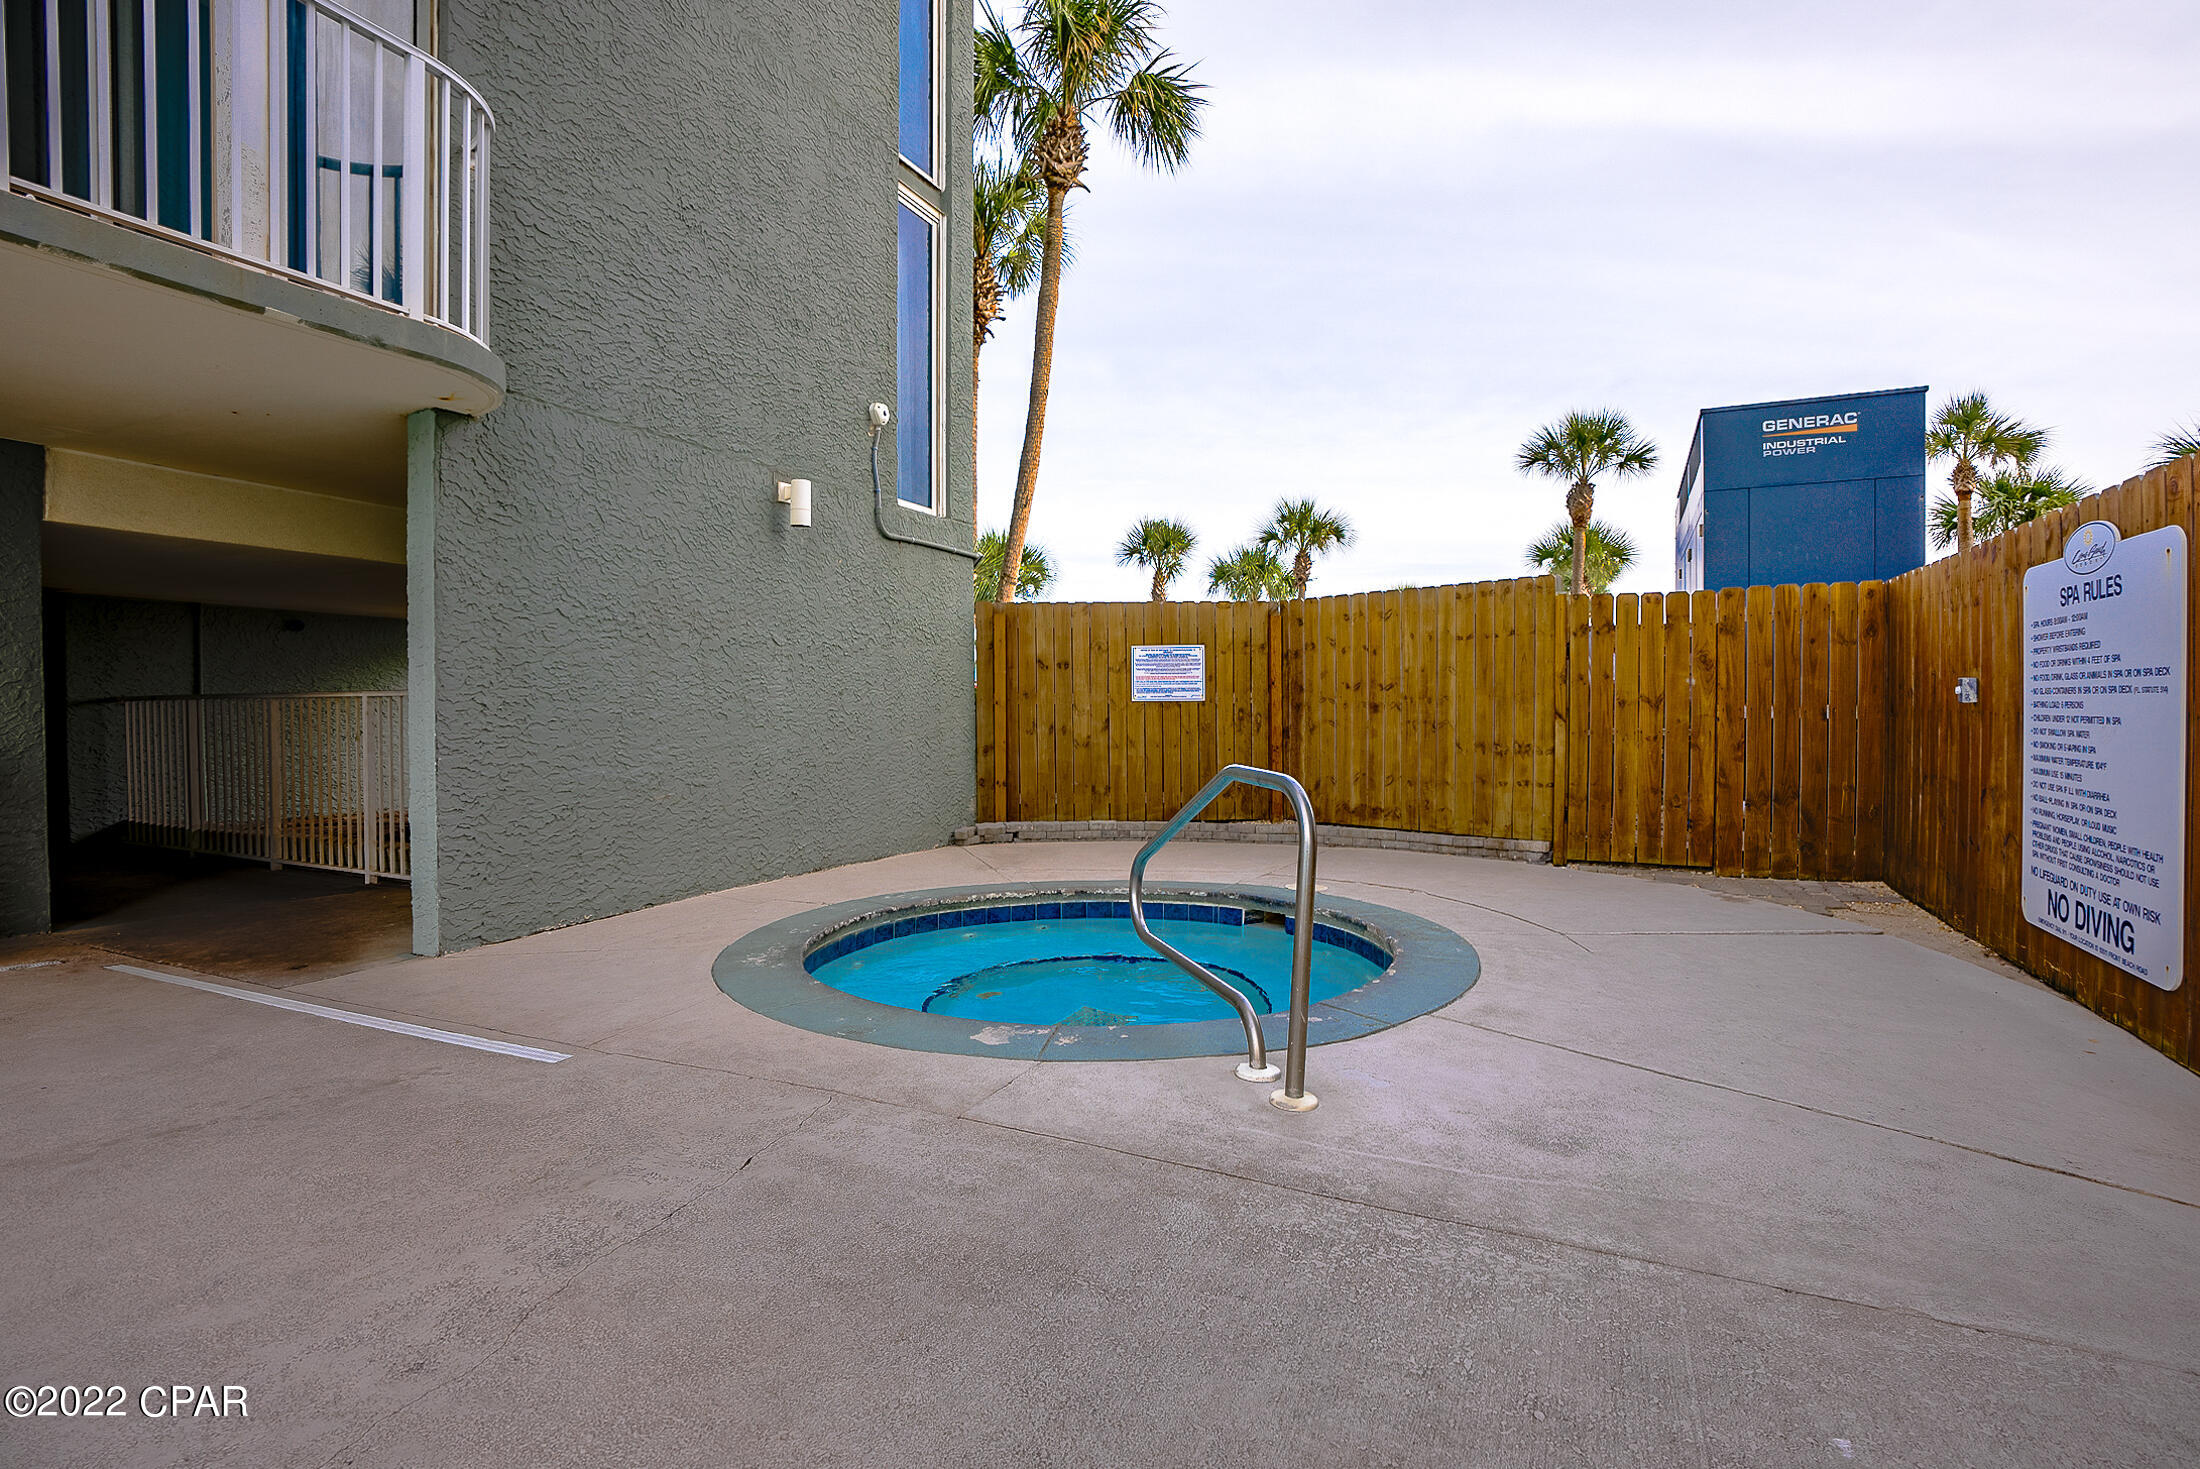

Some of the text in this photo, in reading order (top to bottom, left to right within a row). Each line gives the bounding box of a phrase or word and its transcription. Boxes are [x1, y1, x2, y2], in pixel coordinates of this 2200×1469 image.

[1762, 412, 1858, 432] GENERAC
[1762, 436, 1846, 450] INDUSTRIAL
[1762, 446, 1816, 457] POWER
[2060, 574, 2122, 607] SPA RULES
[2092, 655, 2102, 664] FEET
[2111, 654, 2121, 663] SPA
[2113, 669, 2123, 678] SPA
[2133, 668, 2141, 677] ON
[2142, 667, 2153, 677] SPA
[2154, 666, 2171, 676] DECK
[2108, 686, 2117, 694] SPA
[2118, 686, 2132, 694] DECK
[2112, 716, 2121, 725] SPA
[2104, 807, 2117, 818] DECK
[2088, 819, 2100, 831] LOUD
[2102, 822, 2117, 835] MUSIC
[2062, 838, 2077, 850] PEOPLE
[2078, 844, 2091, 854] USING
[2116, 856, 2145, 871] NARCOTICS
[2147, 864, 2155, 874] OR
[2108, 840, 2126, 853] PEOPLE
[2142, 851, 2164, 864] HEALTH
[2069, 852, 2082, 864] CAUSE
[2084, 856, 2113, 873] DROWSINESS
[2114, 866, 2134, 880] SHOULD
[2136, 874, 2147, 884] NOT
[2148, 877, 2160, 888] USE
[2100, 873, 2120, 887] DOCTOR
[2031, 865, 2161, 925] NO LIFEGUARD ON DUTY USE AT OWN RISK
[2048, 889, 2134, 955] NO DIVING
